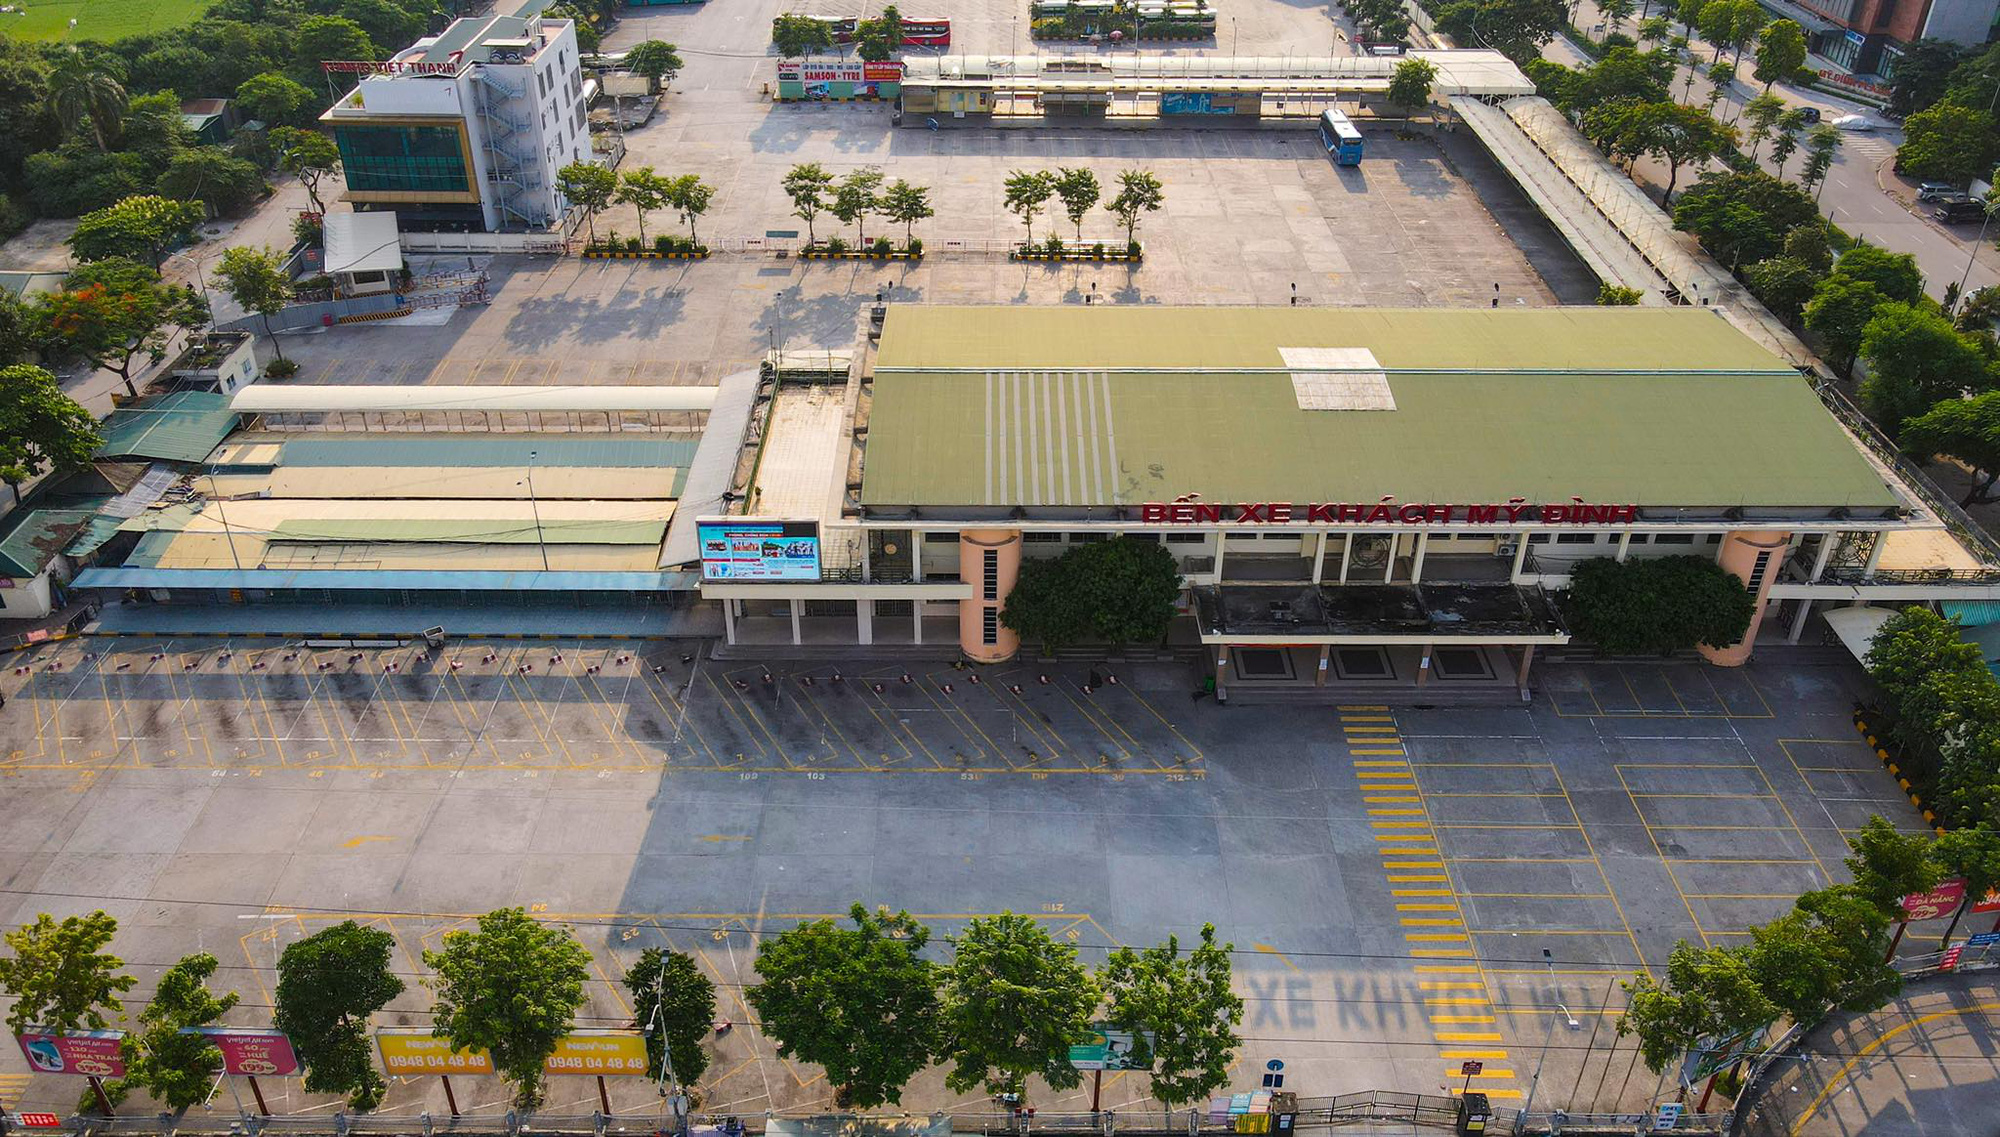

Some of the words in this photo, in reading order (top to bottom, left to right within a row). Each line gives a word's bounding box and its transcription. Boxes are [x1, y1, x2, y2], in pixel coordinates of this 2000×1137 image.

[407, 62, 456, 74] THANH
[804, 71, 836, 80] SAMSON
[842, 71, 860, 80] TYRE
[1142, 492, 1221, 523] BẾN
[1236, 502, 1292, 523] XE
[1307, 494, 1453, 524] KHÁCH
[1467, 497, 1532, 524] MỸ
[1541, 496, 1637, 524] ĐÌNH
[389, 1055, 424, 1067] 0948
[427, 1055, 445, 1067] 04
[448, 1055, 465, 1067] 48
[468, 1055, 486, 1067] 48
[547, 1056, 583, 1068] 0948
[586, 1056, 603, 1068] 04
[606, 1056, 624, 1068] 48
[626, 1056, 644, 1068] 48
